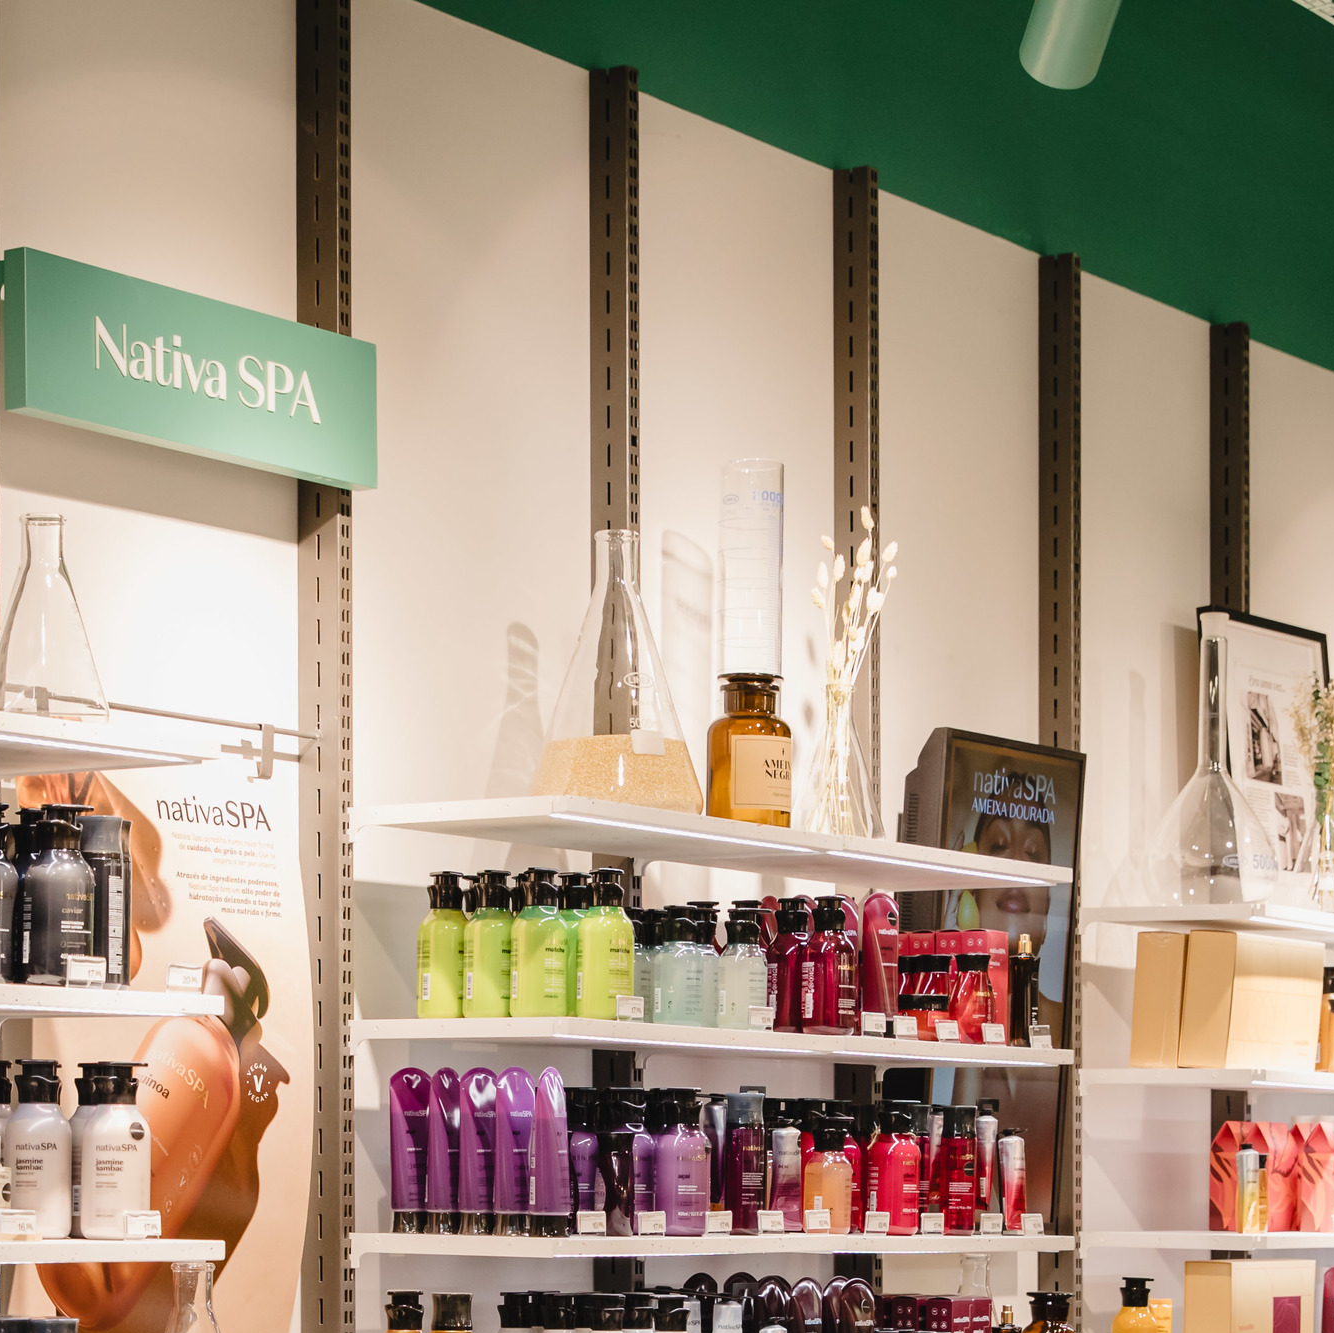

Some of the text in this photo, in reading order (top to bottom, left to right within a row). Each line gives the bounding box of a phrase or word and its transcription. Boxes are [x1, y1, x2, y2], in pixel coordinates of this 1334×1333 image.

[95, 315, 322, 425] Nativa SPA
[973, 768, 1056, 805] nativaSPA
[157, 796, 271, 832] nativaSPA
[971, 797, 1055, 825] AMEIXA DOURADA
[247, 1063, 267, 1076] VEGAN
[248, 1090, 269, 1103] VEGAN
[96, 1144, 138, 1152] nativaSPA
